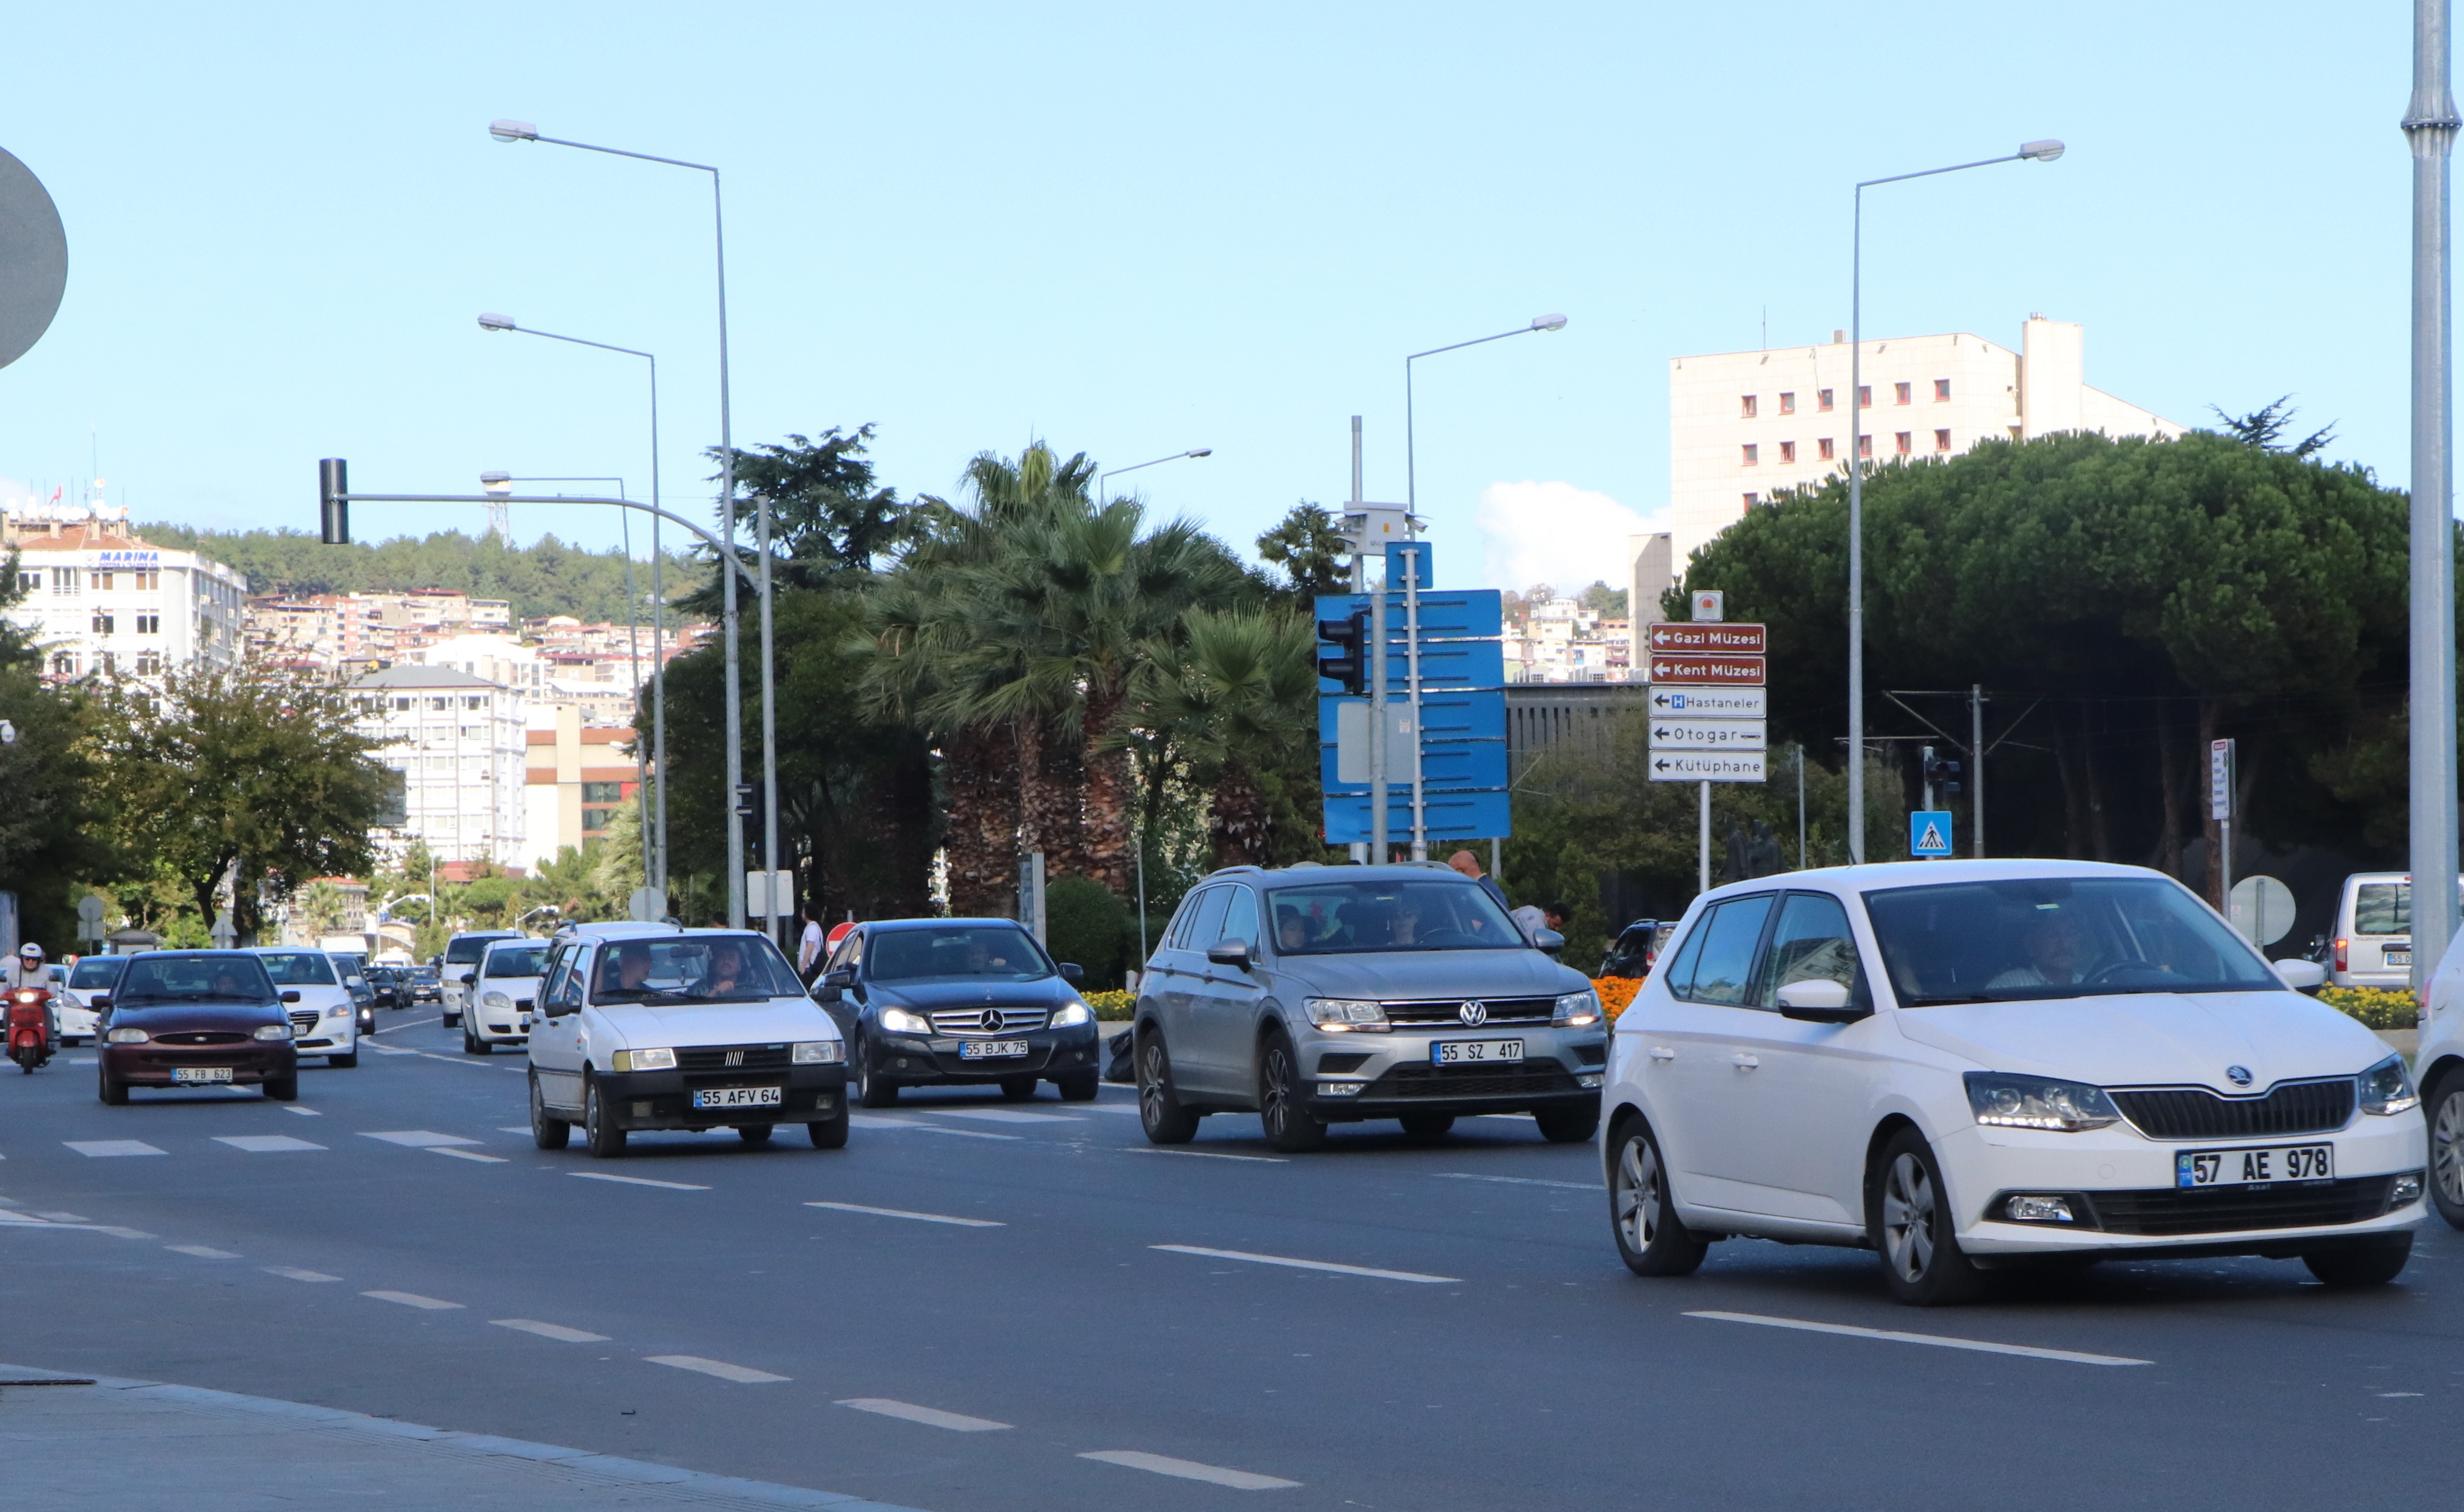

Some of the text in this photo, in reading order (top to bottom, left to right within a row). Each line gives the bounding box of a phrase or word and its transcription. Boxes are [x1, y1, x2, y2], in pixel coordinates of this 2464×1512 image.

[100, 552, 159, 562] MARINA
[1674, 632, 1760, 644] Gazi Müzesi
[1675, 664, 1760, 676] Kent Müzesi
[1686, 697, 1759, 708] Hastaneler
[1675, 728, 1737, 743] Otogar
[1676, 759, 1760, 774] Kütüphane
[966, 1042, 1026, 1054] 55 BJK 75
[1442, 1045, 1458, 1060] 55
[1468, 1044, 1483, 1059] SZ
[1499, 1043, 1520, 1058] 417
[178, 1068, 231, 1079] 55 FB 623
[703, 1089, 779, 1104] 55 AFV 64
[2193, 1154, 2221, 1183] 57
[2242, 1152, 2271, 1180] AE
[2287, 1148, 2328, 1178] 978
